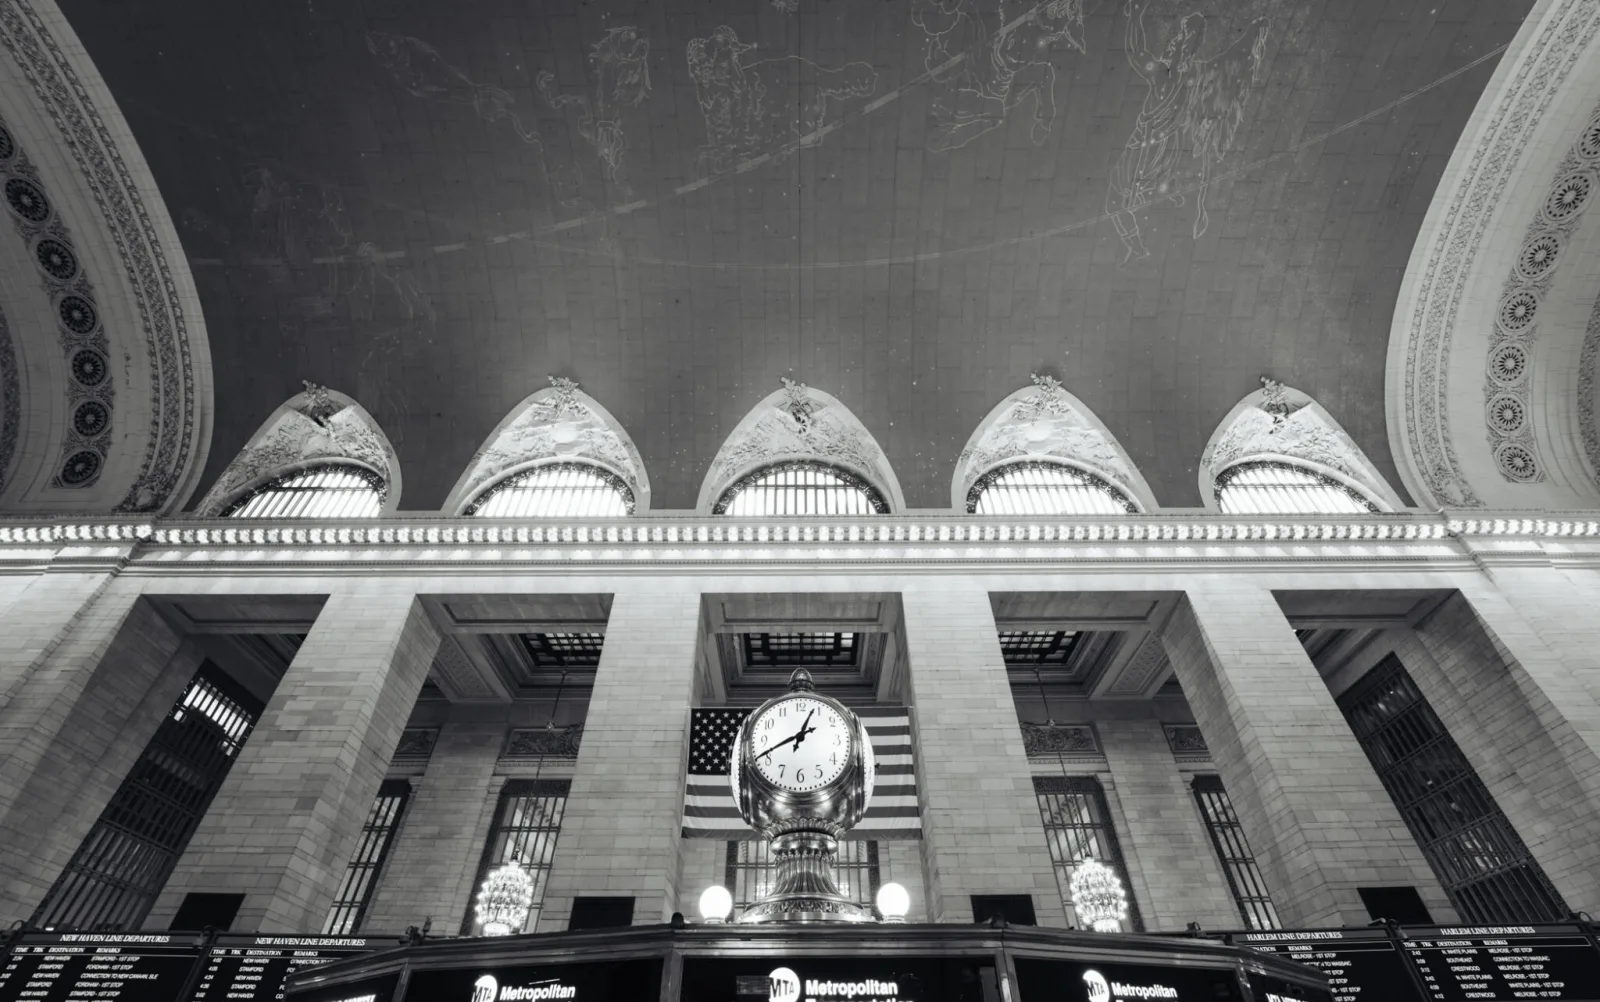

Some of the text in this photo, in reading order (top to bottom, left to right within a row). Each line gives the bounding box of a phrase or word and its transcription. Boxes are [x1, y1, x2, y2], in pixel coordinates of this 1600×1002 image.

[779, 707, 787, 717] 11
[795, 702, 806, 712] 12
[764, 718, 774, 730] 10
[829, 716, 836, 727] 2
[761, 734, 768, 748] 9
[833, 734, 841, 746] 3
[764, 751, 772, 766] 8
[829, 752, 838, 765] 4
[778, 764, 786, 778] 7
[796, 768, 804, 783] 6
[814, 764, 823, 779] 5
[1246, 933, 1277, 941] HARLEM
[1296, 932, 1343, 940] DEPARTURES
[1470, 927, 1489, 935] LINE
[499, 984, 576, 1002] Metropolitan
[769, 977, 898, 999] MTA Metropolitan
[1086, 979, 1178, 999] MTA Metropolitan
